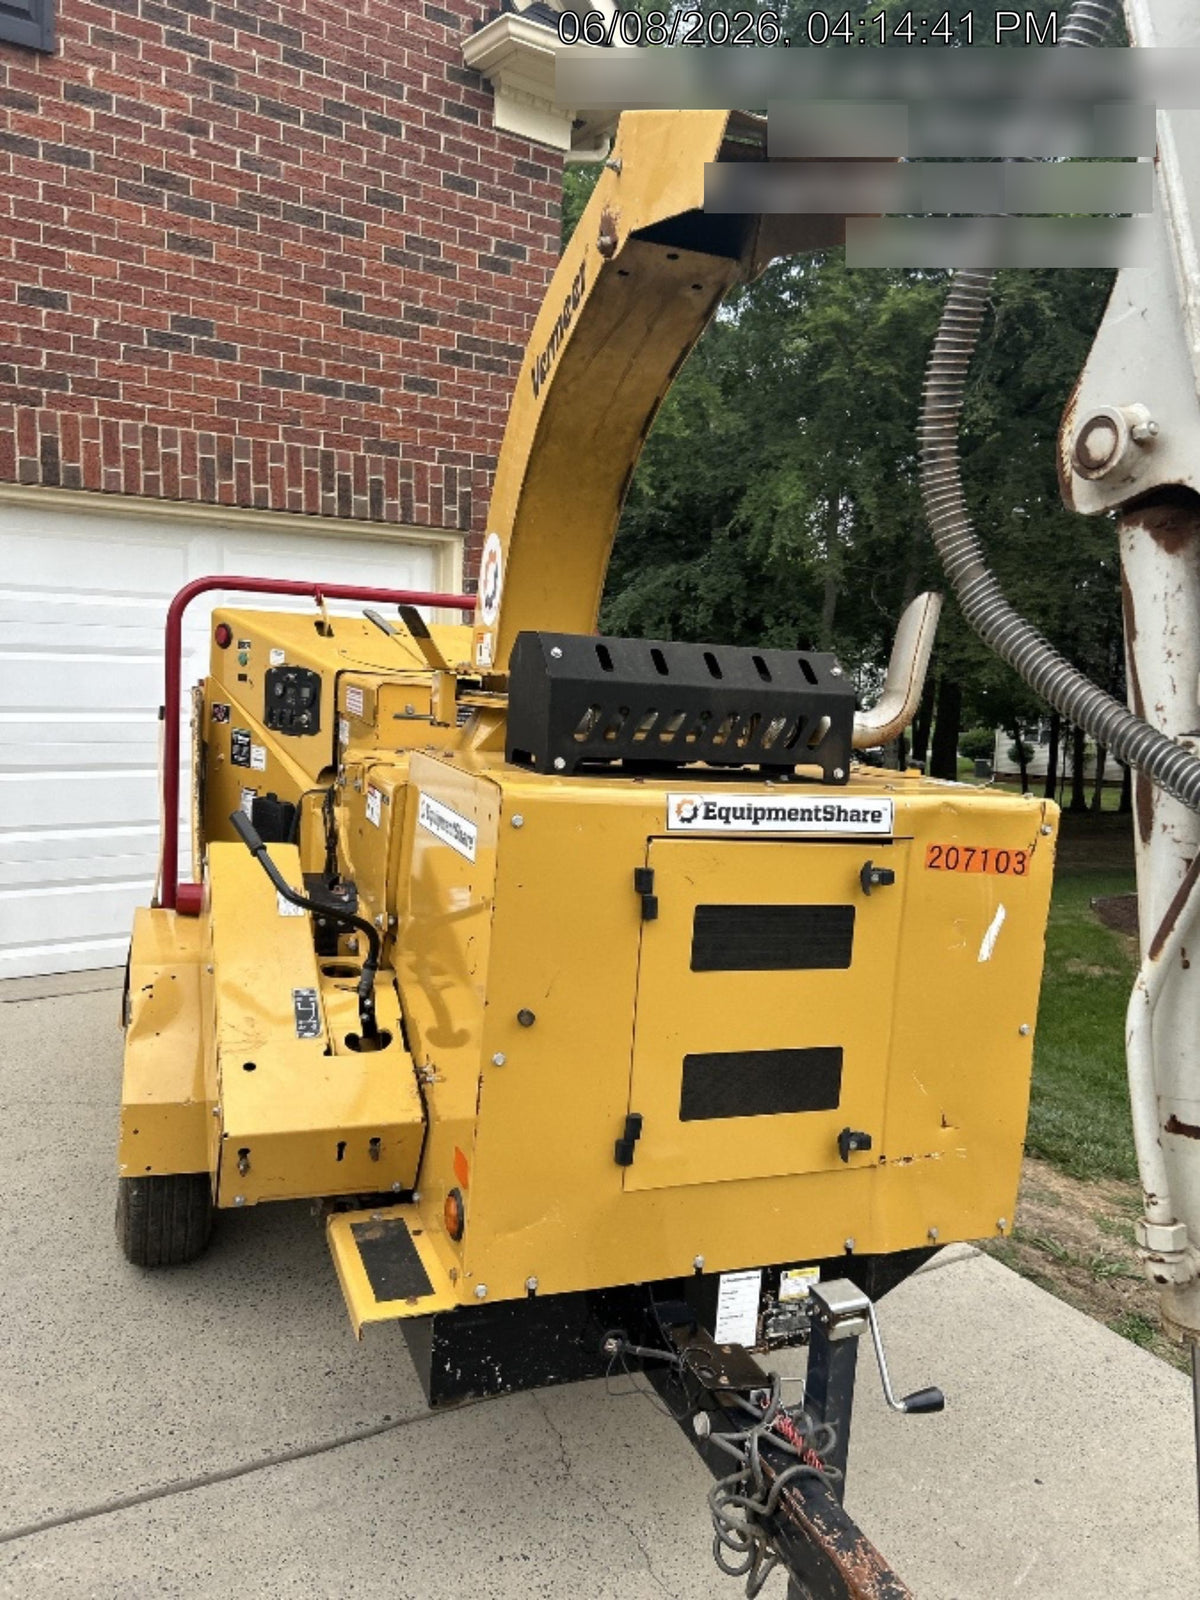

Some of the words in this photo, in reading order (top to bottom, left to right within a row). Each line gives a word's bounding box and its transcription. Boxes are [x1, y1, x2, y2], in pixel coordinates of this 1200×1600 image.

[531, 259, 586, 400] Vermeer
[702, 801, 883, 825] EquipmentShare
[927, 845, 1027, 875] 207103
